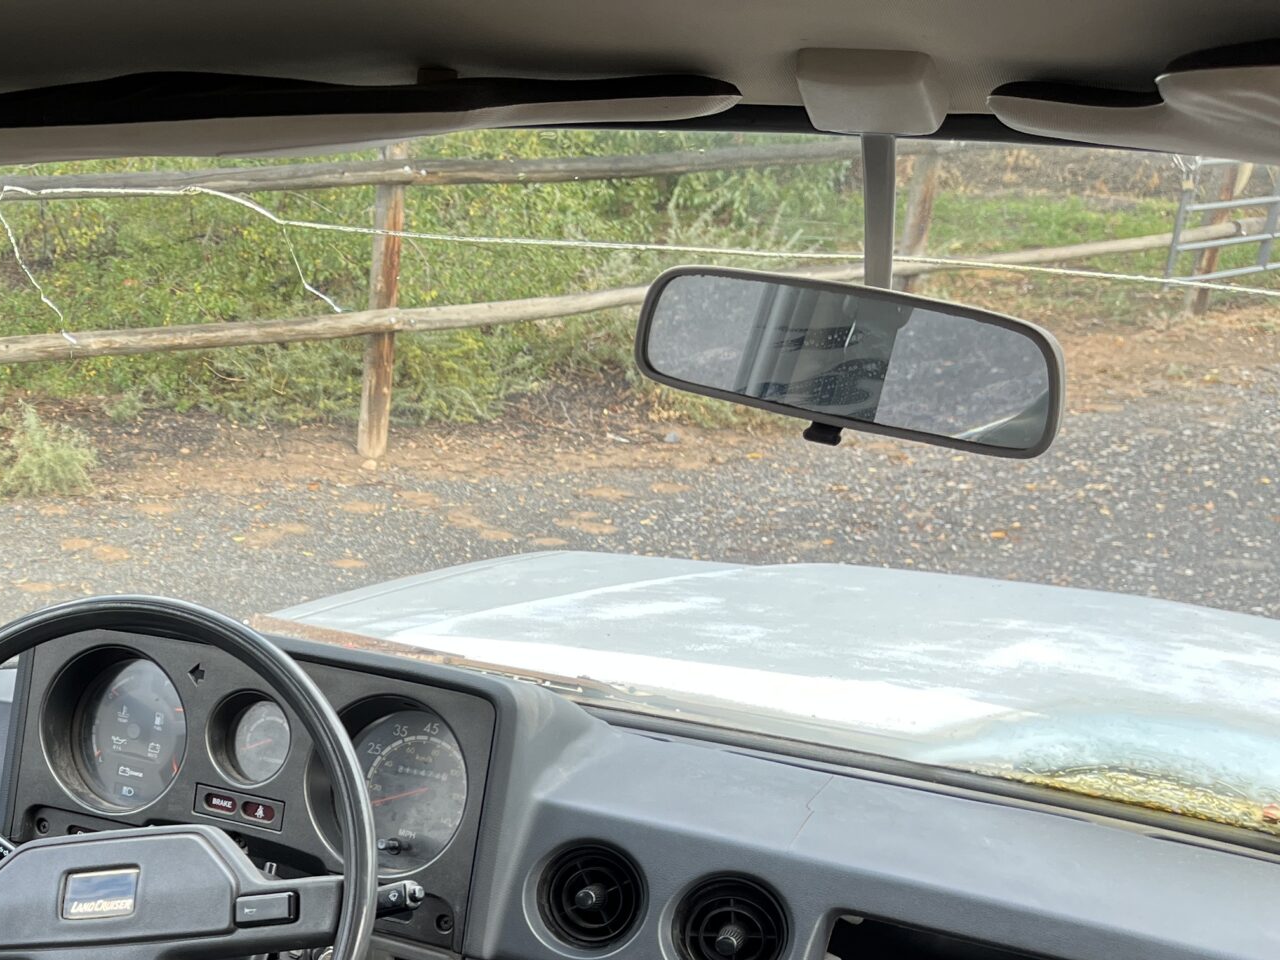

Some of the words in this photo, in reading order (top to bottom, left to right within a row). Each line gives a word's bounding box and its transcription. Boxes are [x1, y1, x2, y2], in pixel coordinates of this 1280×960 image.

[393, 724, 409, 737] 35
[423, 722, 440, 735] 45
[368, 742, 382, 755] 25
[211, 797, 233, 809] BRAKE
[398, 828, 417, 839] MPH
